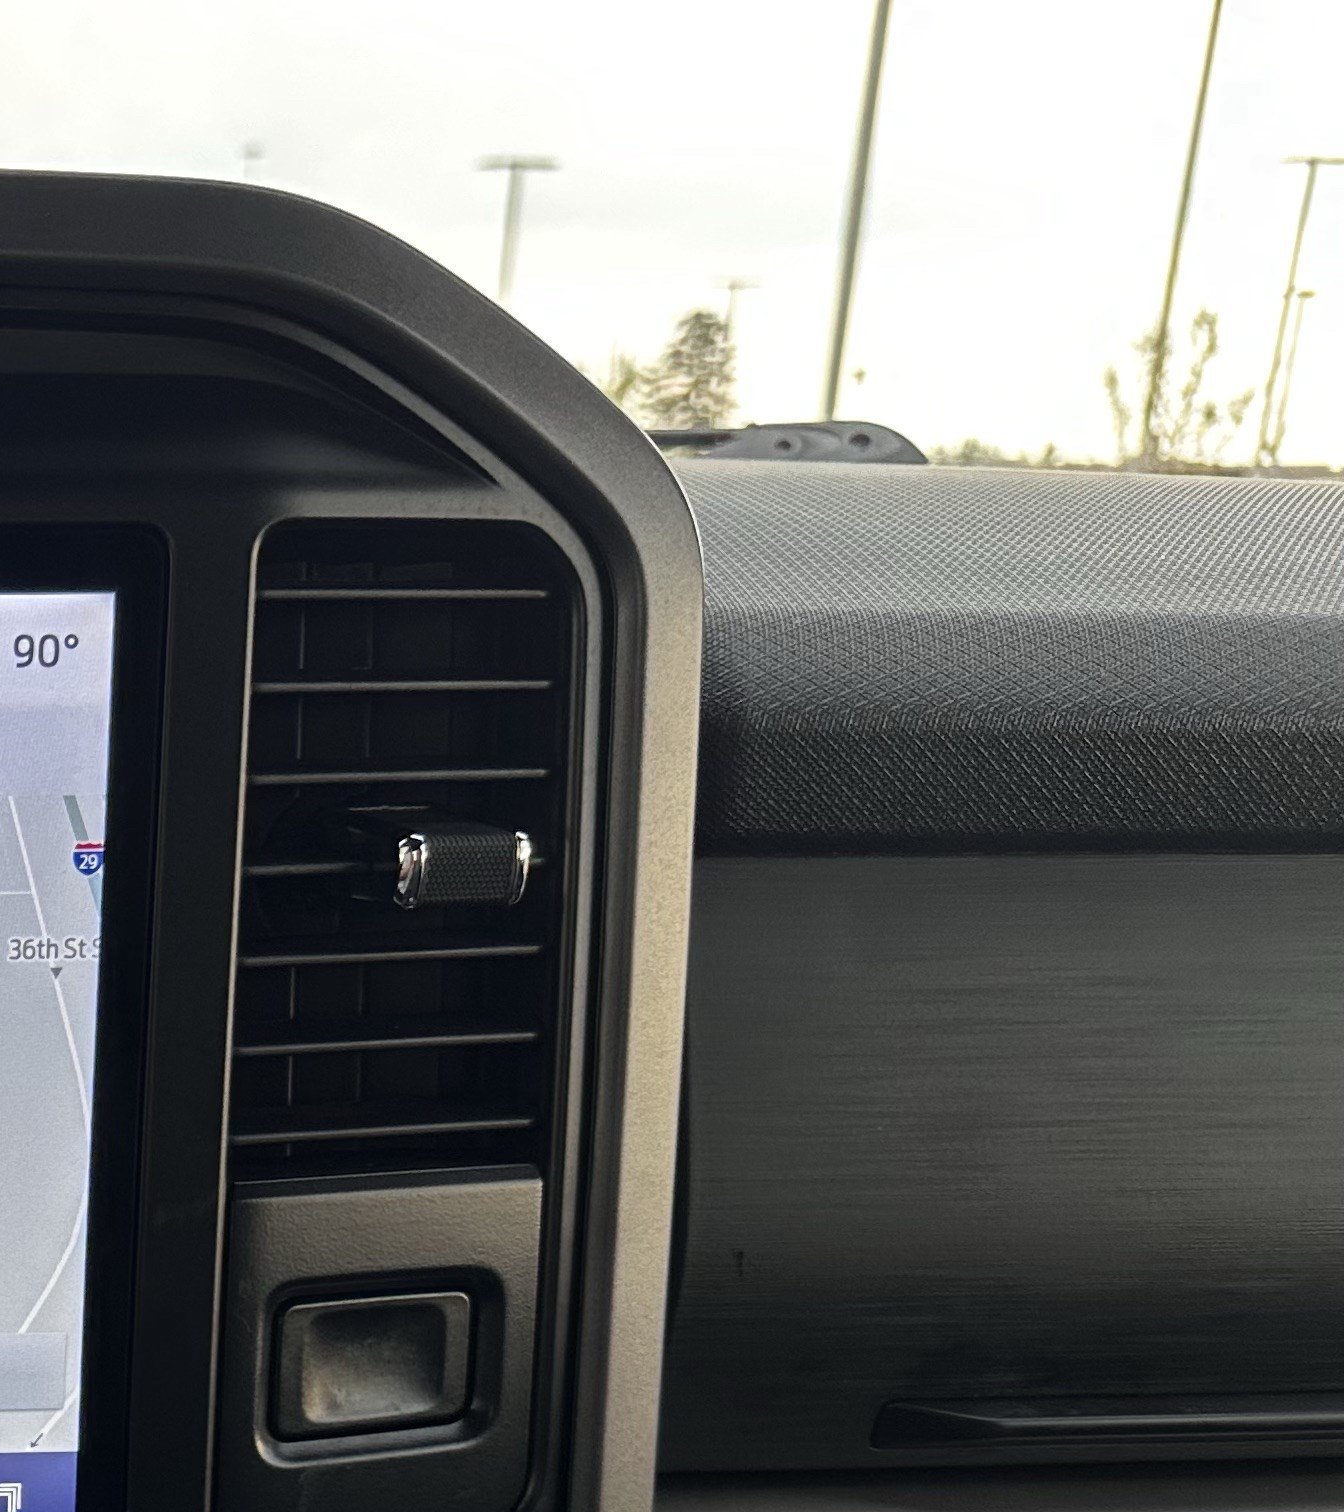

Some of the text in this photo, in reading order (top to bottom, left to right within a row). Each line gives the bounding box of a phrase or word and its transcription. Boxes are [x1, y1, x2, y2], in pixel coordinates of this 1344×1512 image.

[79, 854, 98, 869] 29
[9, 938, 59, 960] 36th
[64, 938, 87, 959] St
